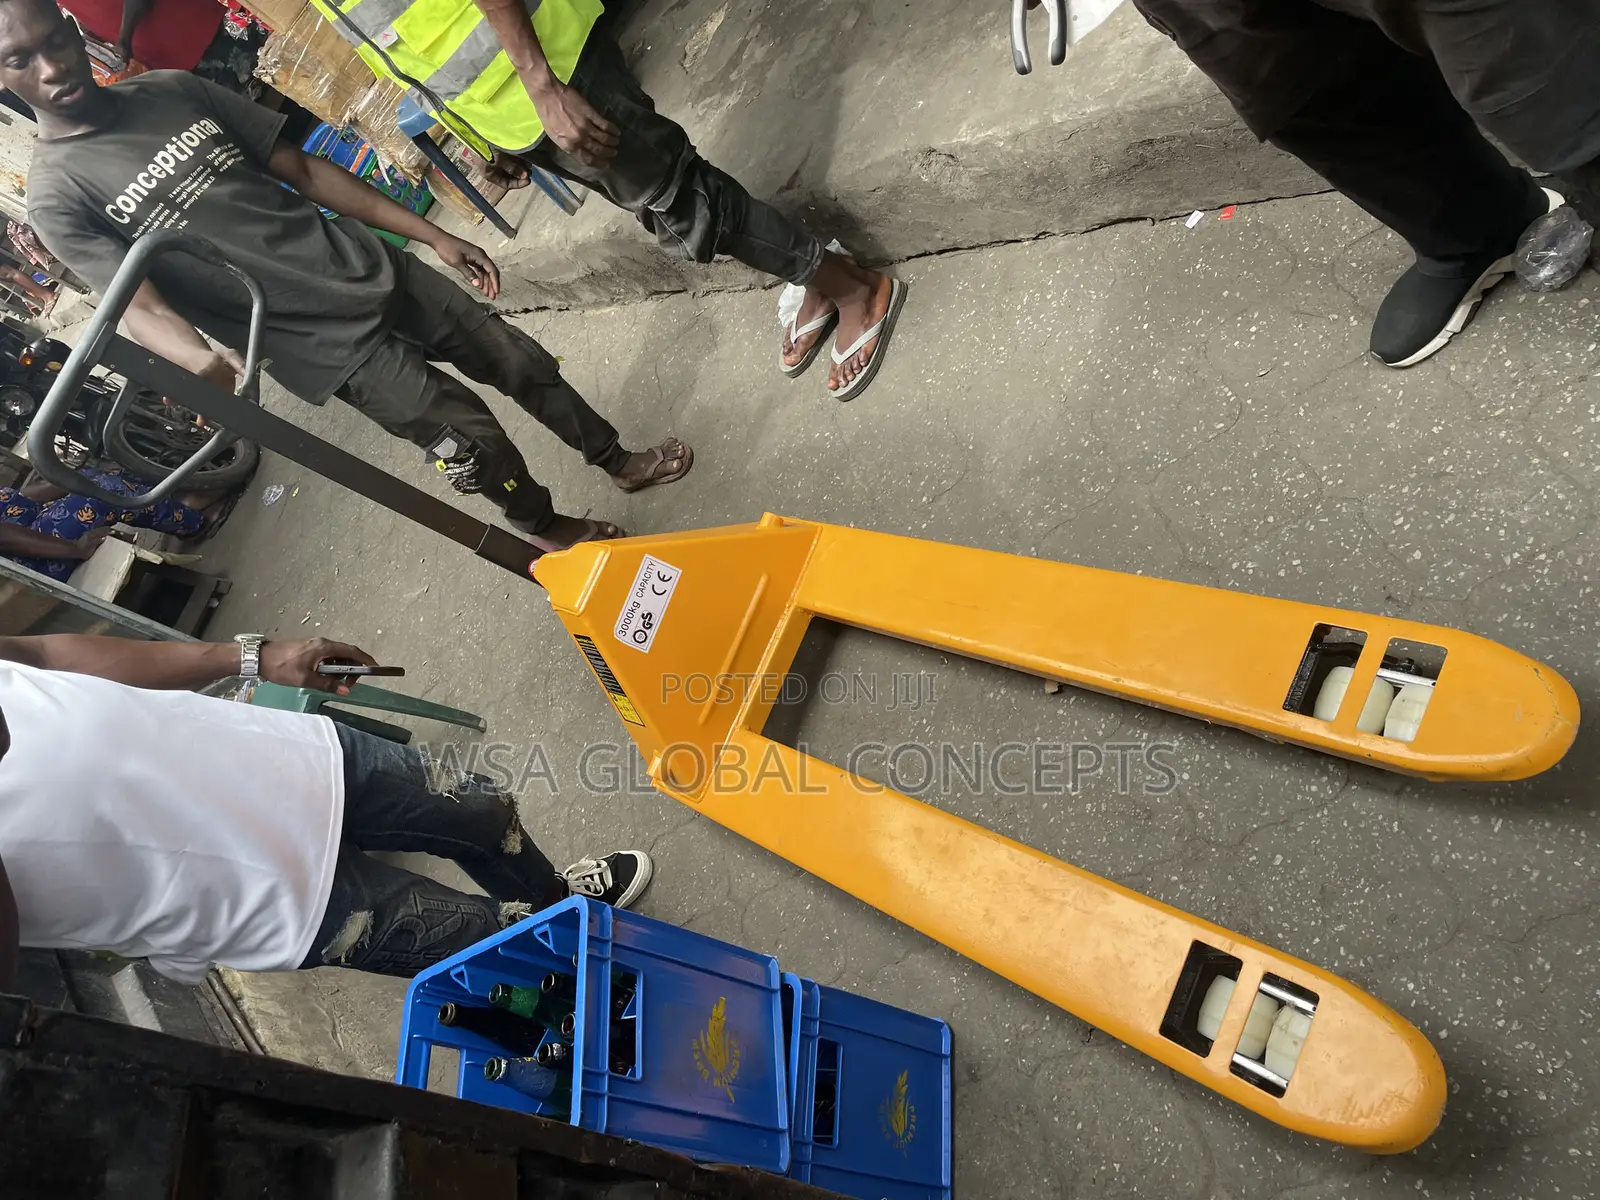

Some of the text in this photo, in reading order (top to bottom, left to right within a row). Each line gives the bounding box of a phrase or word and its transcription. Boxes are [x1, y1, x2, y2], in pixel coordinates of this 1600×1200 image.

[105, 117, 223, 224] Conceptional
[619, 560, 656, 637] 3000kg CAPACITY
